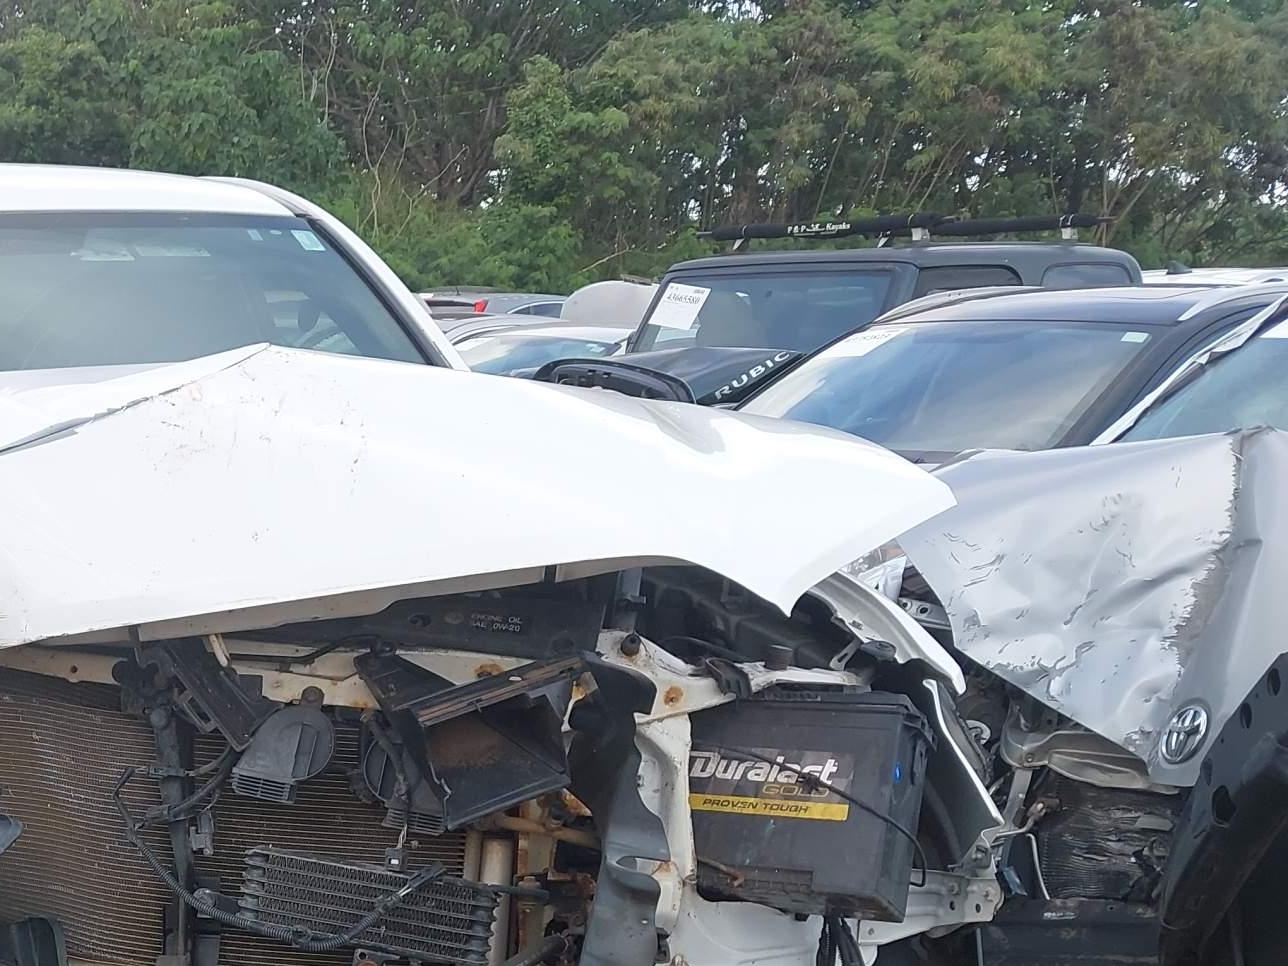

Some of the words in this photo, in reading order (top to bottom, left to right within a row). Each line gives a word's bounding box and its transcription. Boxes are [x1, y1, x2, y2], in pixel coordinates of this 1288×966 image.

[826, 222, 851, 235] Kayaks
[508, 616, 523, 624] OIL
[702, 798, 759, 810] PROVEN
[763, 802, 809, 814] TOUGH
